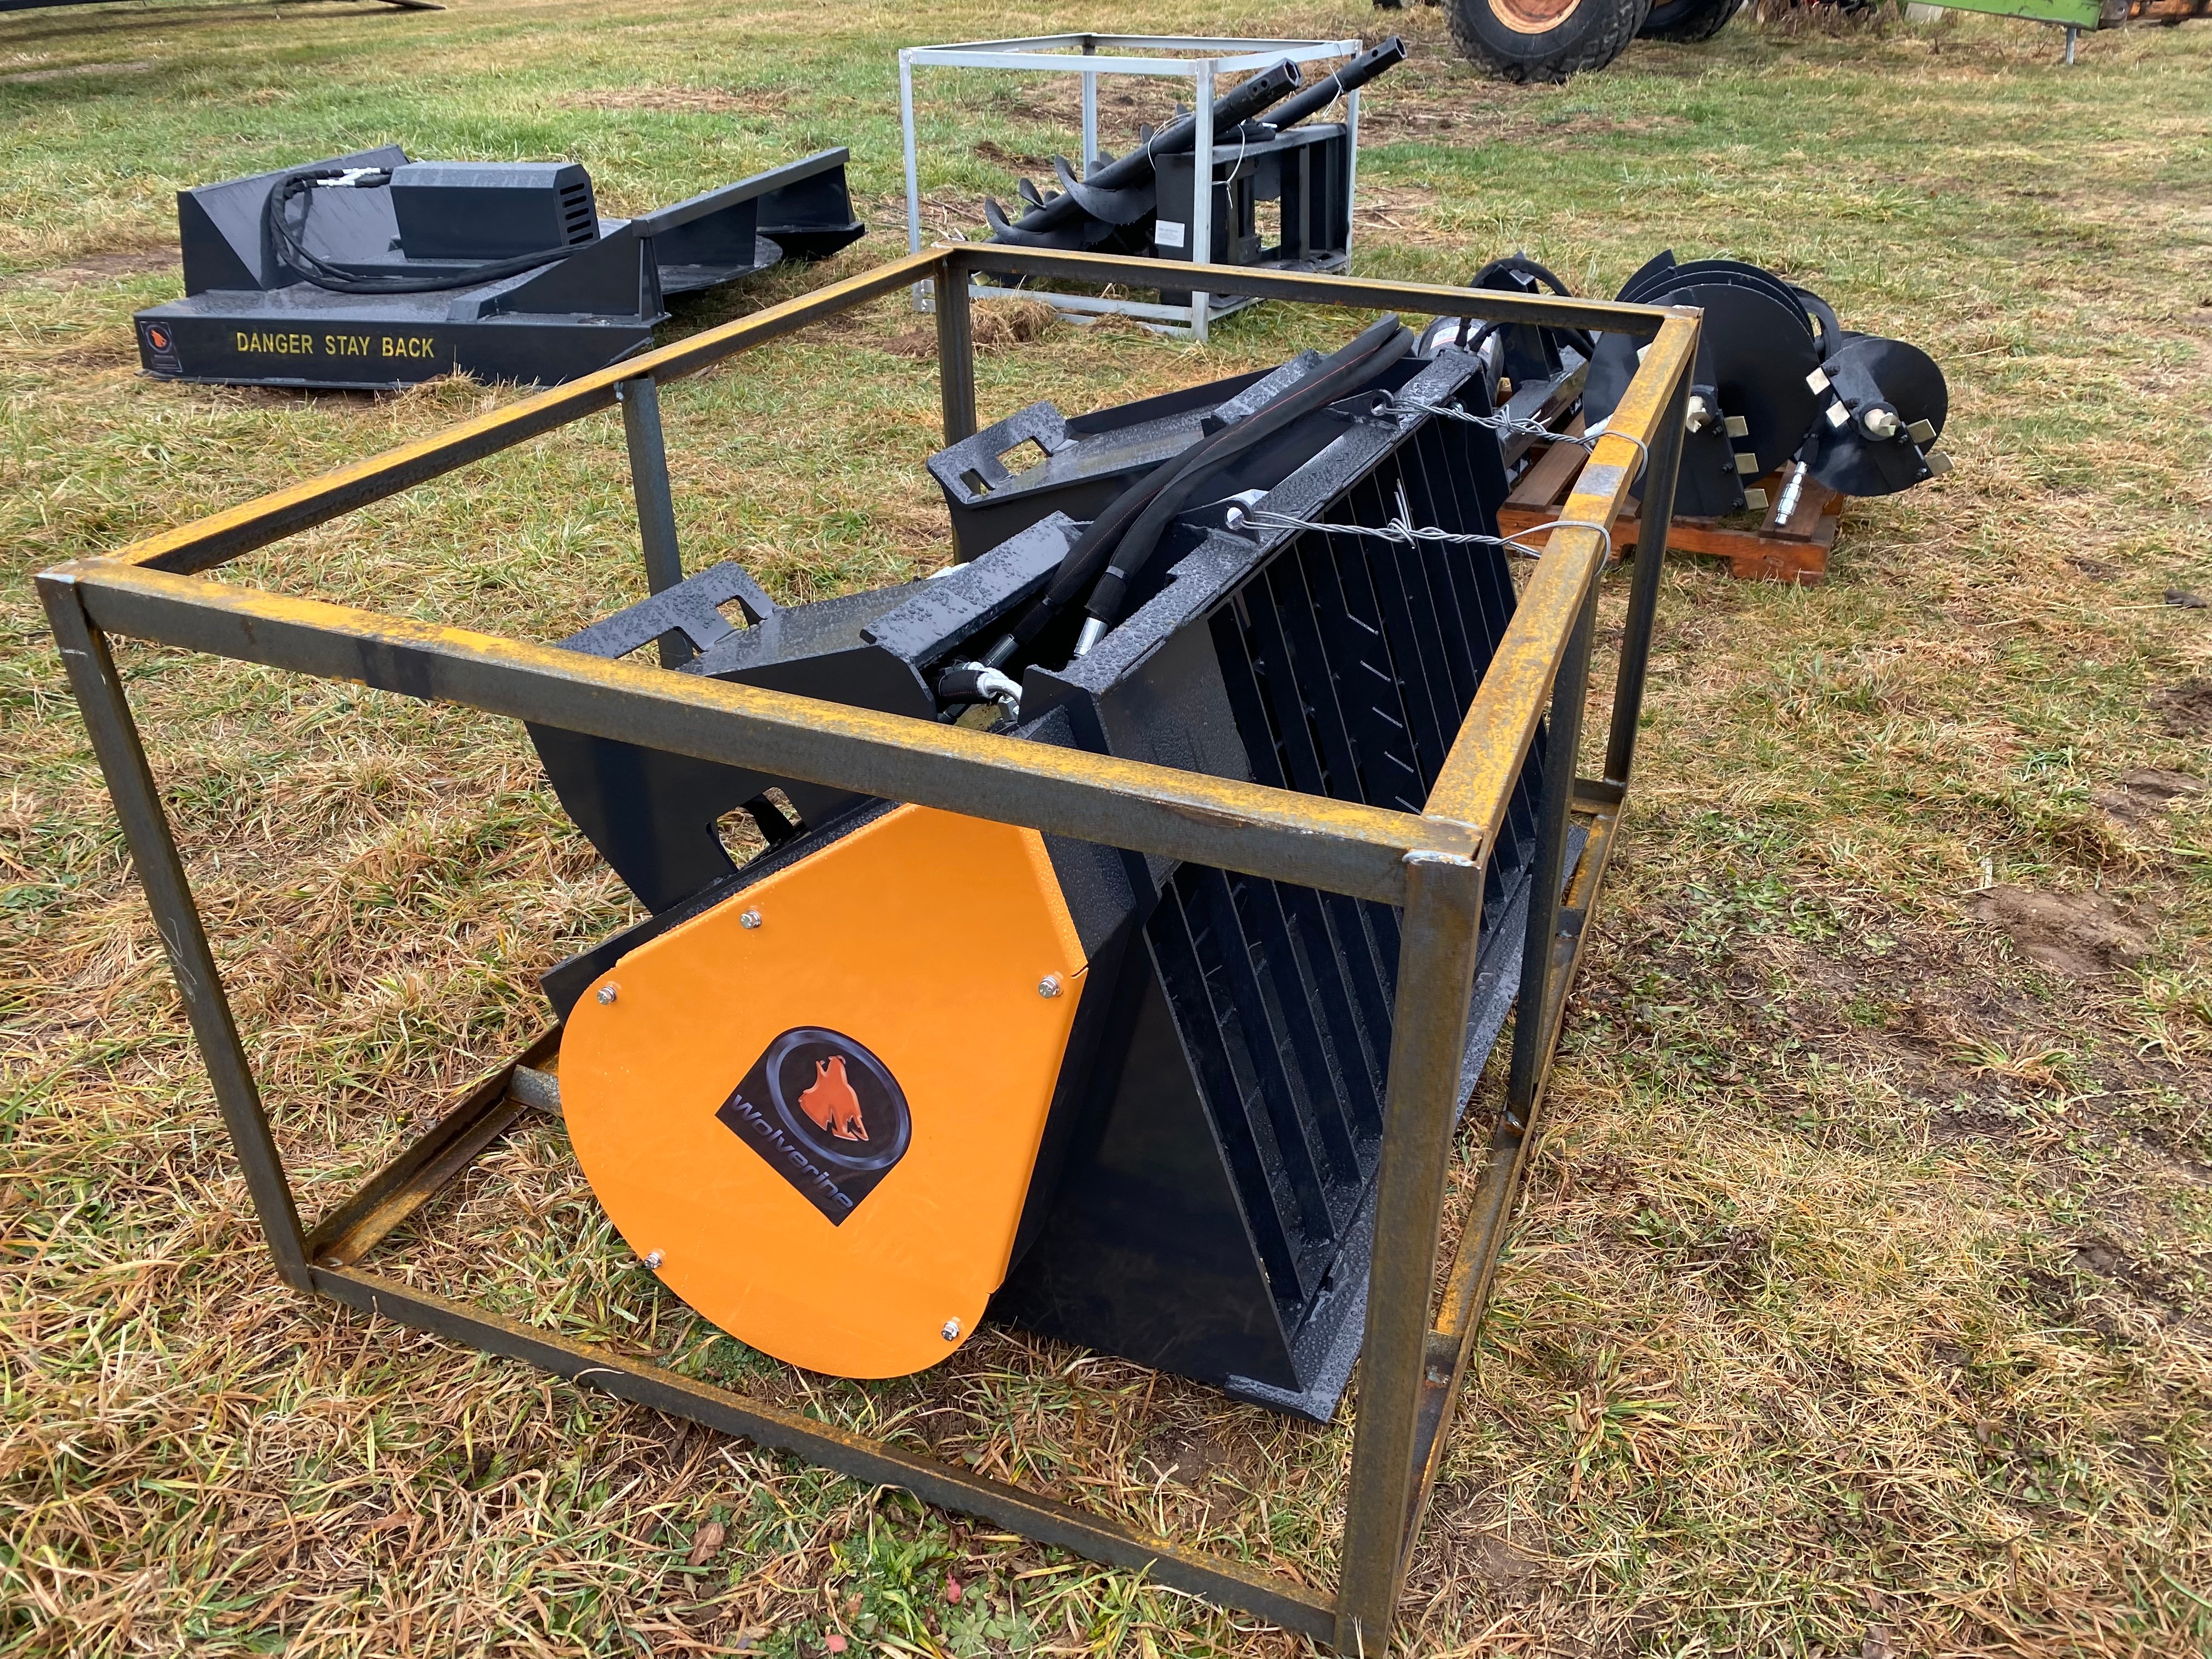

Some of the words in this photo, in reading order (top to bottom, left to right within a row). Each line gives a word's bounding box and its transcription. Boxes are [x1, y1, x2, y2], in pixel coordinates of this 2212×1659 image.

[236, 331, 313, 353] DANGER
[325, 335, 370, 356] STAY
[381, 336, 435, 358] BACK
[730, 1094, 854, 1209] Wolverine
